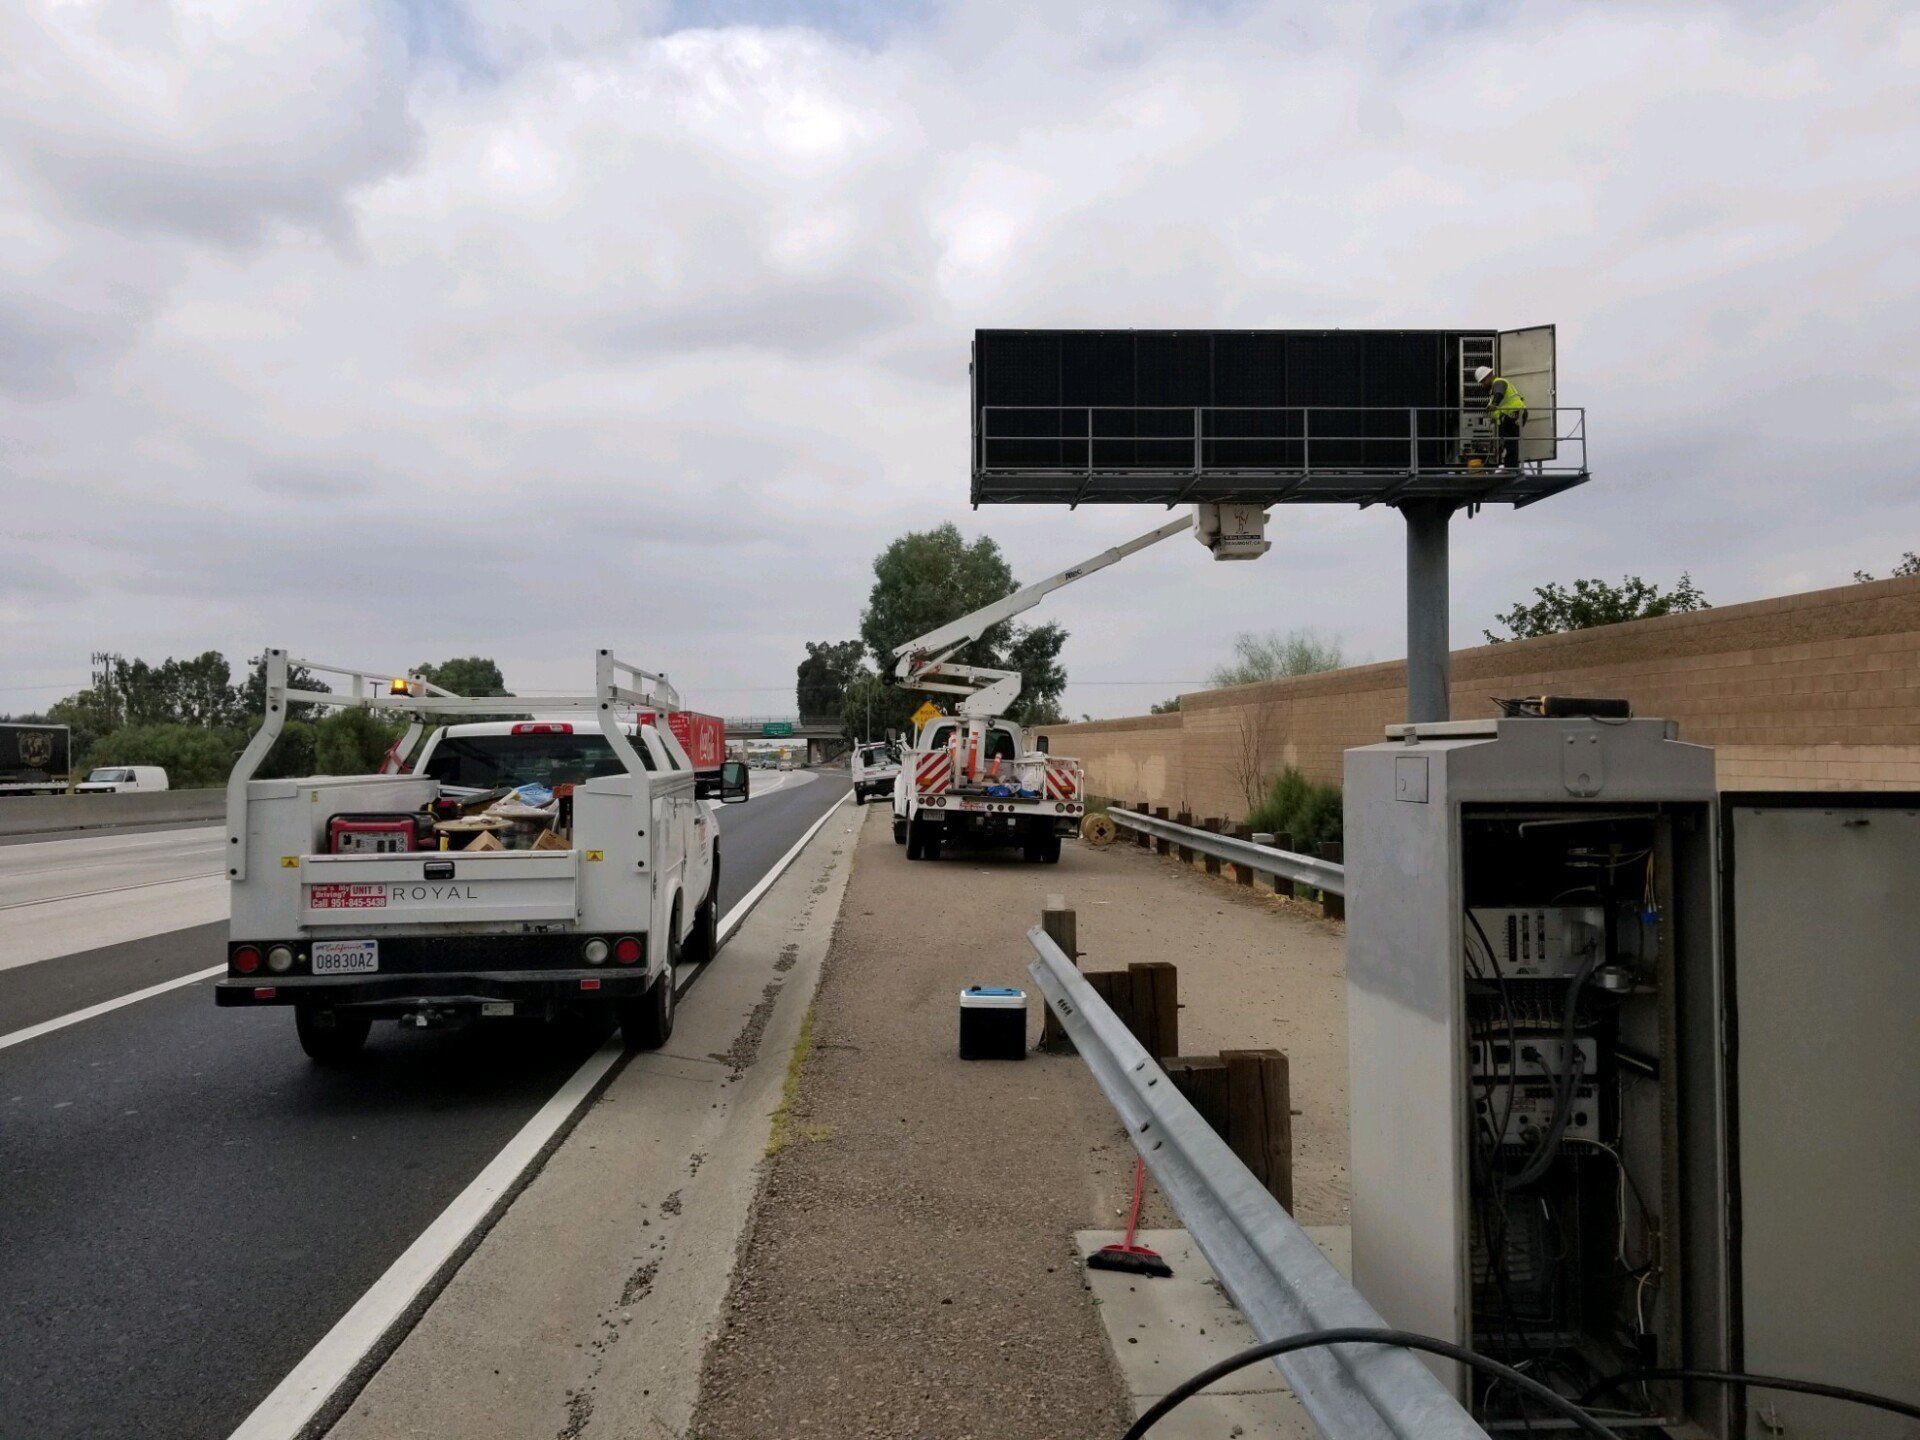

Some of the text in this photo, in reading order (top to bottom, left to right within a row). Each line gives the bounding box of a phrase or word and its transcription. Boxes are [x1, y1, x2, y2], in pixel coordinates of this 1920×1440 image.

[352, 886, 383, 894] UNIT 9
[392, 886, 478, 900] ROYAL
[312, 899, 328, 908] Call
[316, 952, 374, 969] 08830A2
